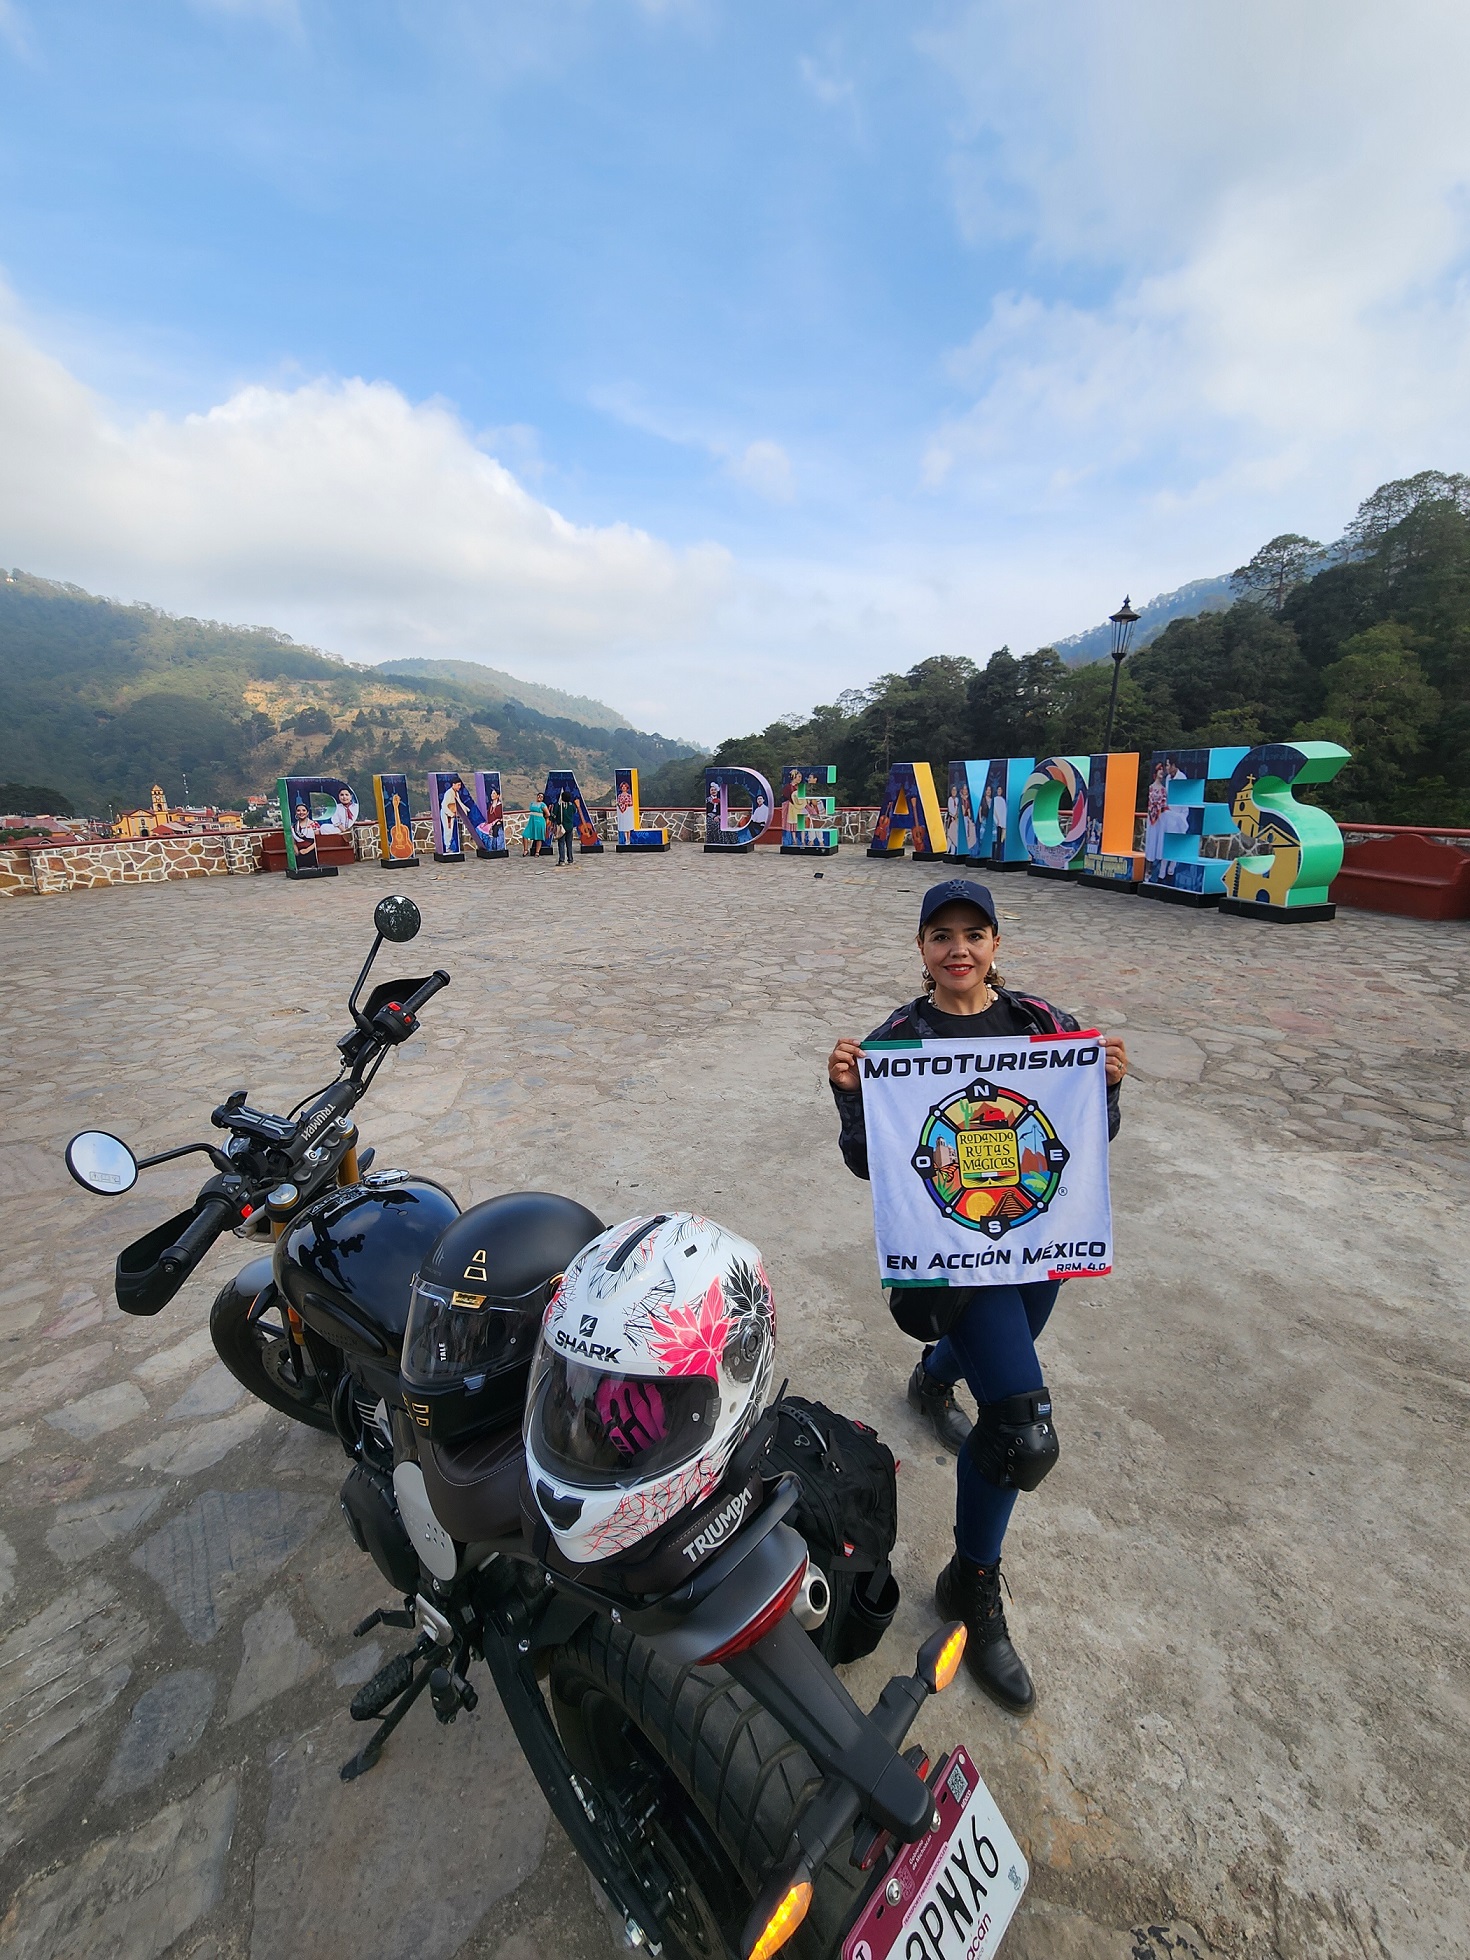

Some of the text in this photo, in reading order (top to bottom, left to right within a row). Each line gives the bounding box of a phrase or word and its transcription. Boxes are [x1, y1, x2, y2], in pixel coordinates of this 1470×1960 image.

[277, 740, 1352, 908] PINAL DE AMOLES
[864, 1046, 1100, 1079] MOTOTURISMO
[973, 1084, 990, 1097] N
[301, 1103, 337, 1142] TRIUMPH
[915, 1155, 931, 1168] O
[1049, 1149, 1064, 1161] E
[988, 1220, 1002, 1233] S
[886, 1240, 1107, 1271] EN ACCIÓN MÉXICO
[1055, 1262, 1106, 1273] RRM 4.0
[438, 1342, 447, 1362] TALE
[554, 1329, 623, 1365] SHARK
[682, 1487, 753, 1563] TRIUMPH
